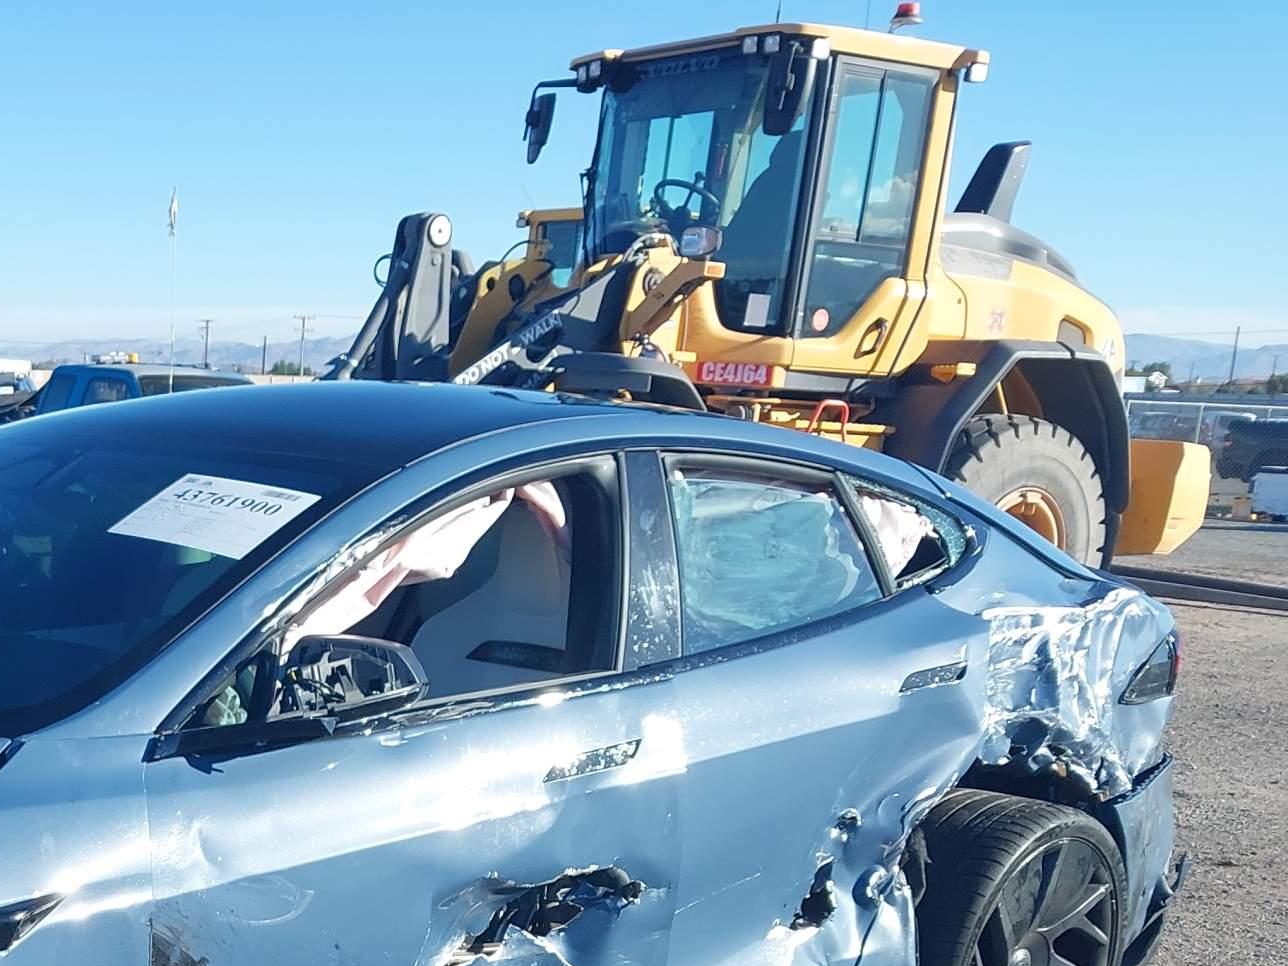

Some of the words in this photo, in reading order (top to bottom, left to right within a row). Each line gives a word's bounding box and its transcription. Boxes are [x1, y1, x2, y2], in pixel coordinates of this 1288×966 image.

[455, 365, 480, 385] DO
[481, 348, 509, 374] NOT
[519, 314, 559, 345] WALK
[173, 488, 283, 516] 43761900
